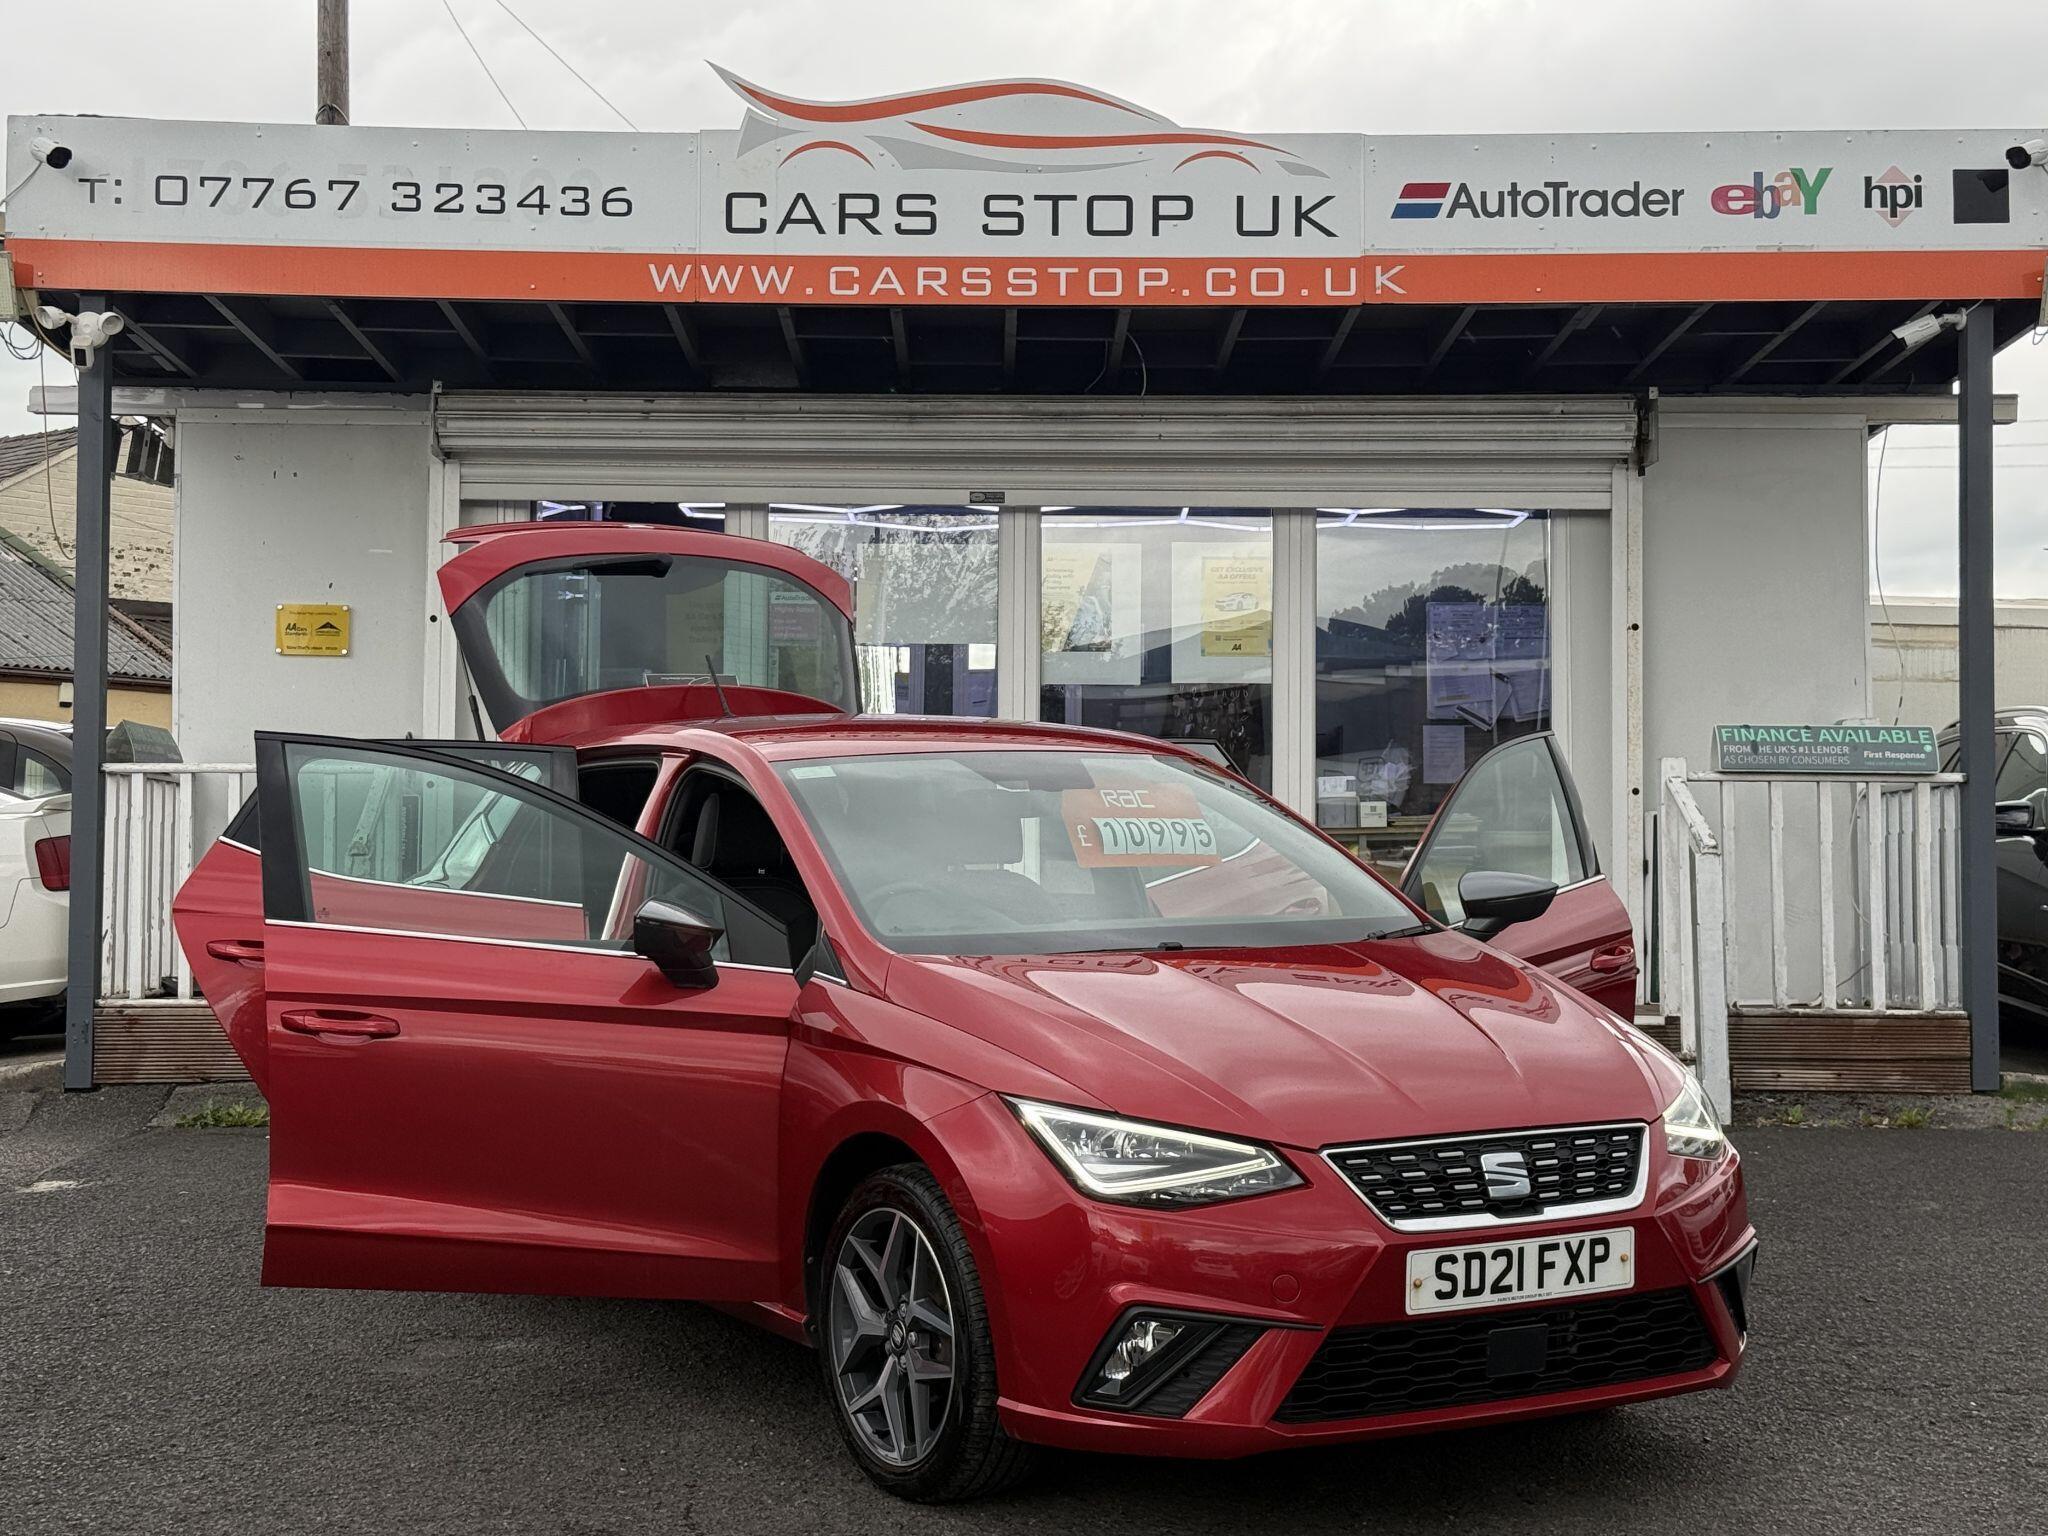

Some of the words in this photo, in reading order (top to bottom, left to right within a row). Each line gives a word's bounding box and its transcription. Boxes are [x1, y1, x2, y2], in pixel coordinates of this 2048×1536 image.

[155, 175, 360, 212] 07767
[391, 181, 634, 217] 323436
[1446, 181, 1685, 219] AutoTrader
[1864, 174, 1922, 219] hpi
[725, 192, 938, 235] CARS
[983, 194, 1193, 236] STOP
[1236, 195, 1339, 238] UK
[648, 263, 1407, 298] WWW.CARSSTOP.CO.UK
[1721, 728, 1813, 743] FINANCE
[1819, 729, 1932, 744] AVAILABLE
[1724, 745, 1751, 754] FROM
[1752, 745, 1773, 754] HE
[1774, 745, 1797, 754] UK'S
[1812, 745, 1849, 754] LENDER
[1779, 756, 1790, 765] BY
[1792, 756, 1850, 765] CONSUMERS
[1864, 751, 1882, 759] First
[1885, 751, 1926, 760] Response
[1103, 821, 1212, 848] 10995
[1435, 1246, 1524, 1300] SD21
[1537, 1236, 1610, 1289] FXP
